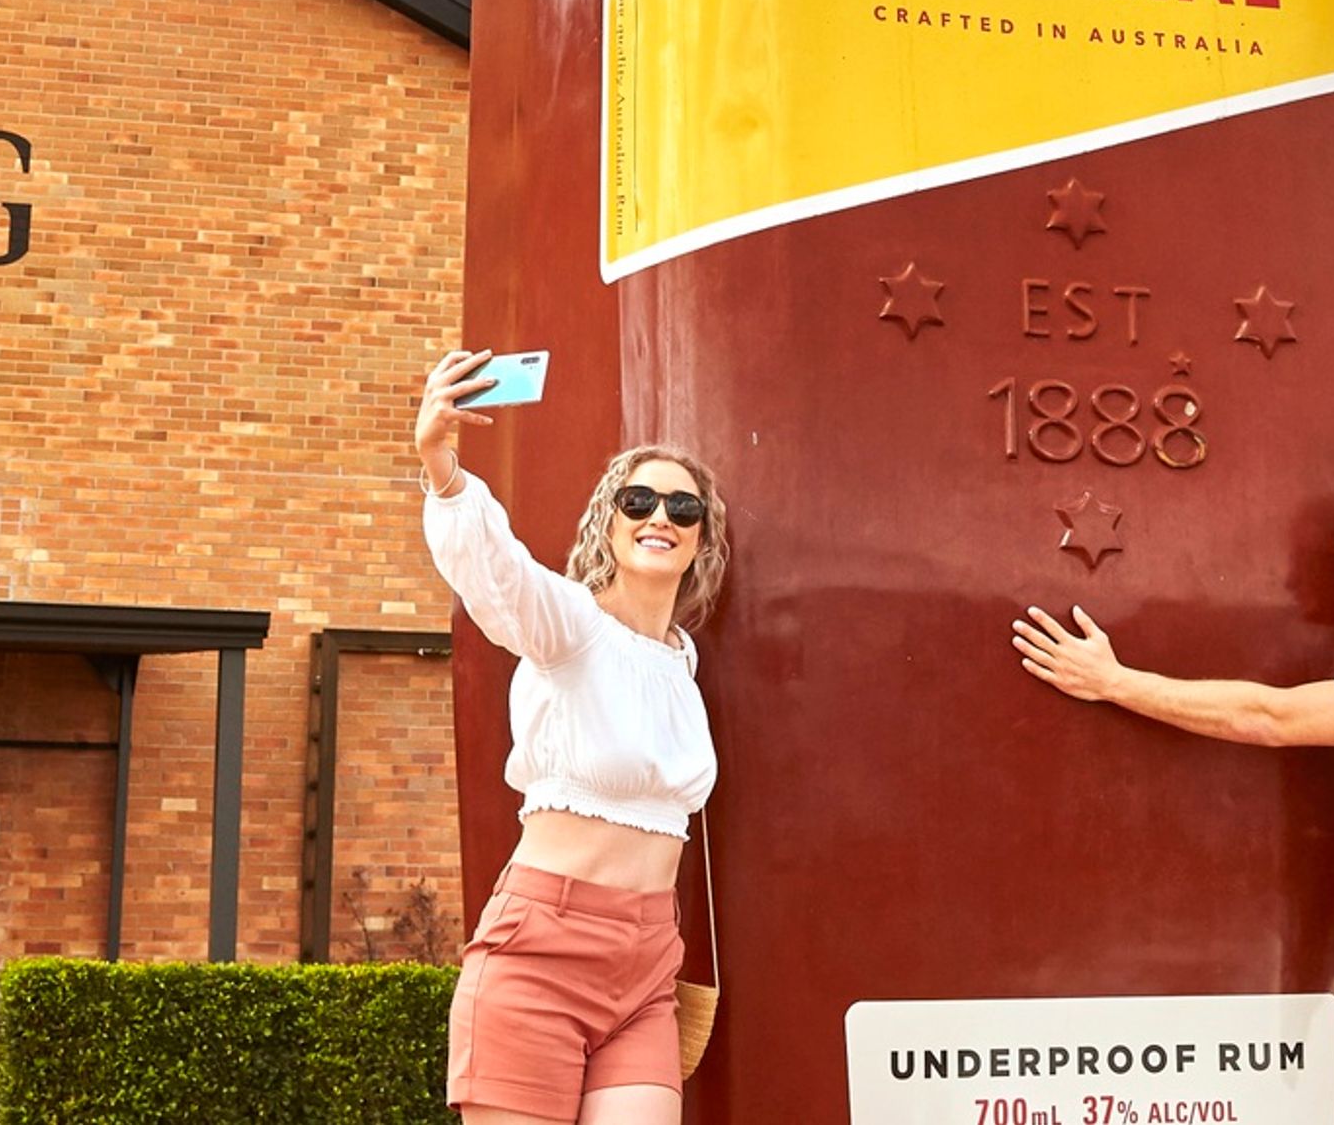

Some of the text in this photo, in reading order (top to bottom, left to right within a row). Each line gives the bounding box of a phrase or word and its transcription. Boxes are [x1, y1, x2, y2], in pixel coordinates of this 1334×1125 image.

[874, 6, 1265, 57] CRAFTED IN AUSTRALIA
[1022, 278, 1151, 345] EST
[987, 376, 1208, 470] 1888
[889, 1041, 1306, 1081] UNDERPROOF RUM
[1082, 1095, 1138, 1125] 37%
[1148, 1101, 1238, 1125] ALC/VOL
